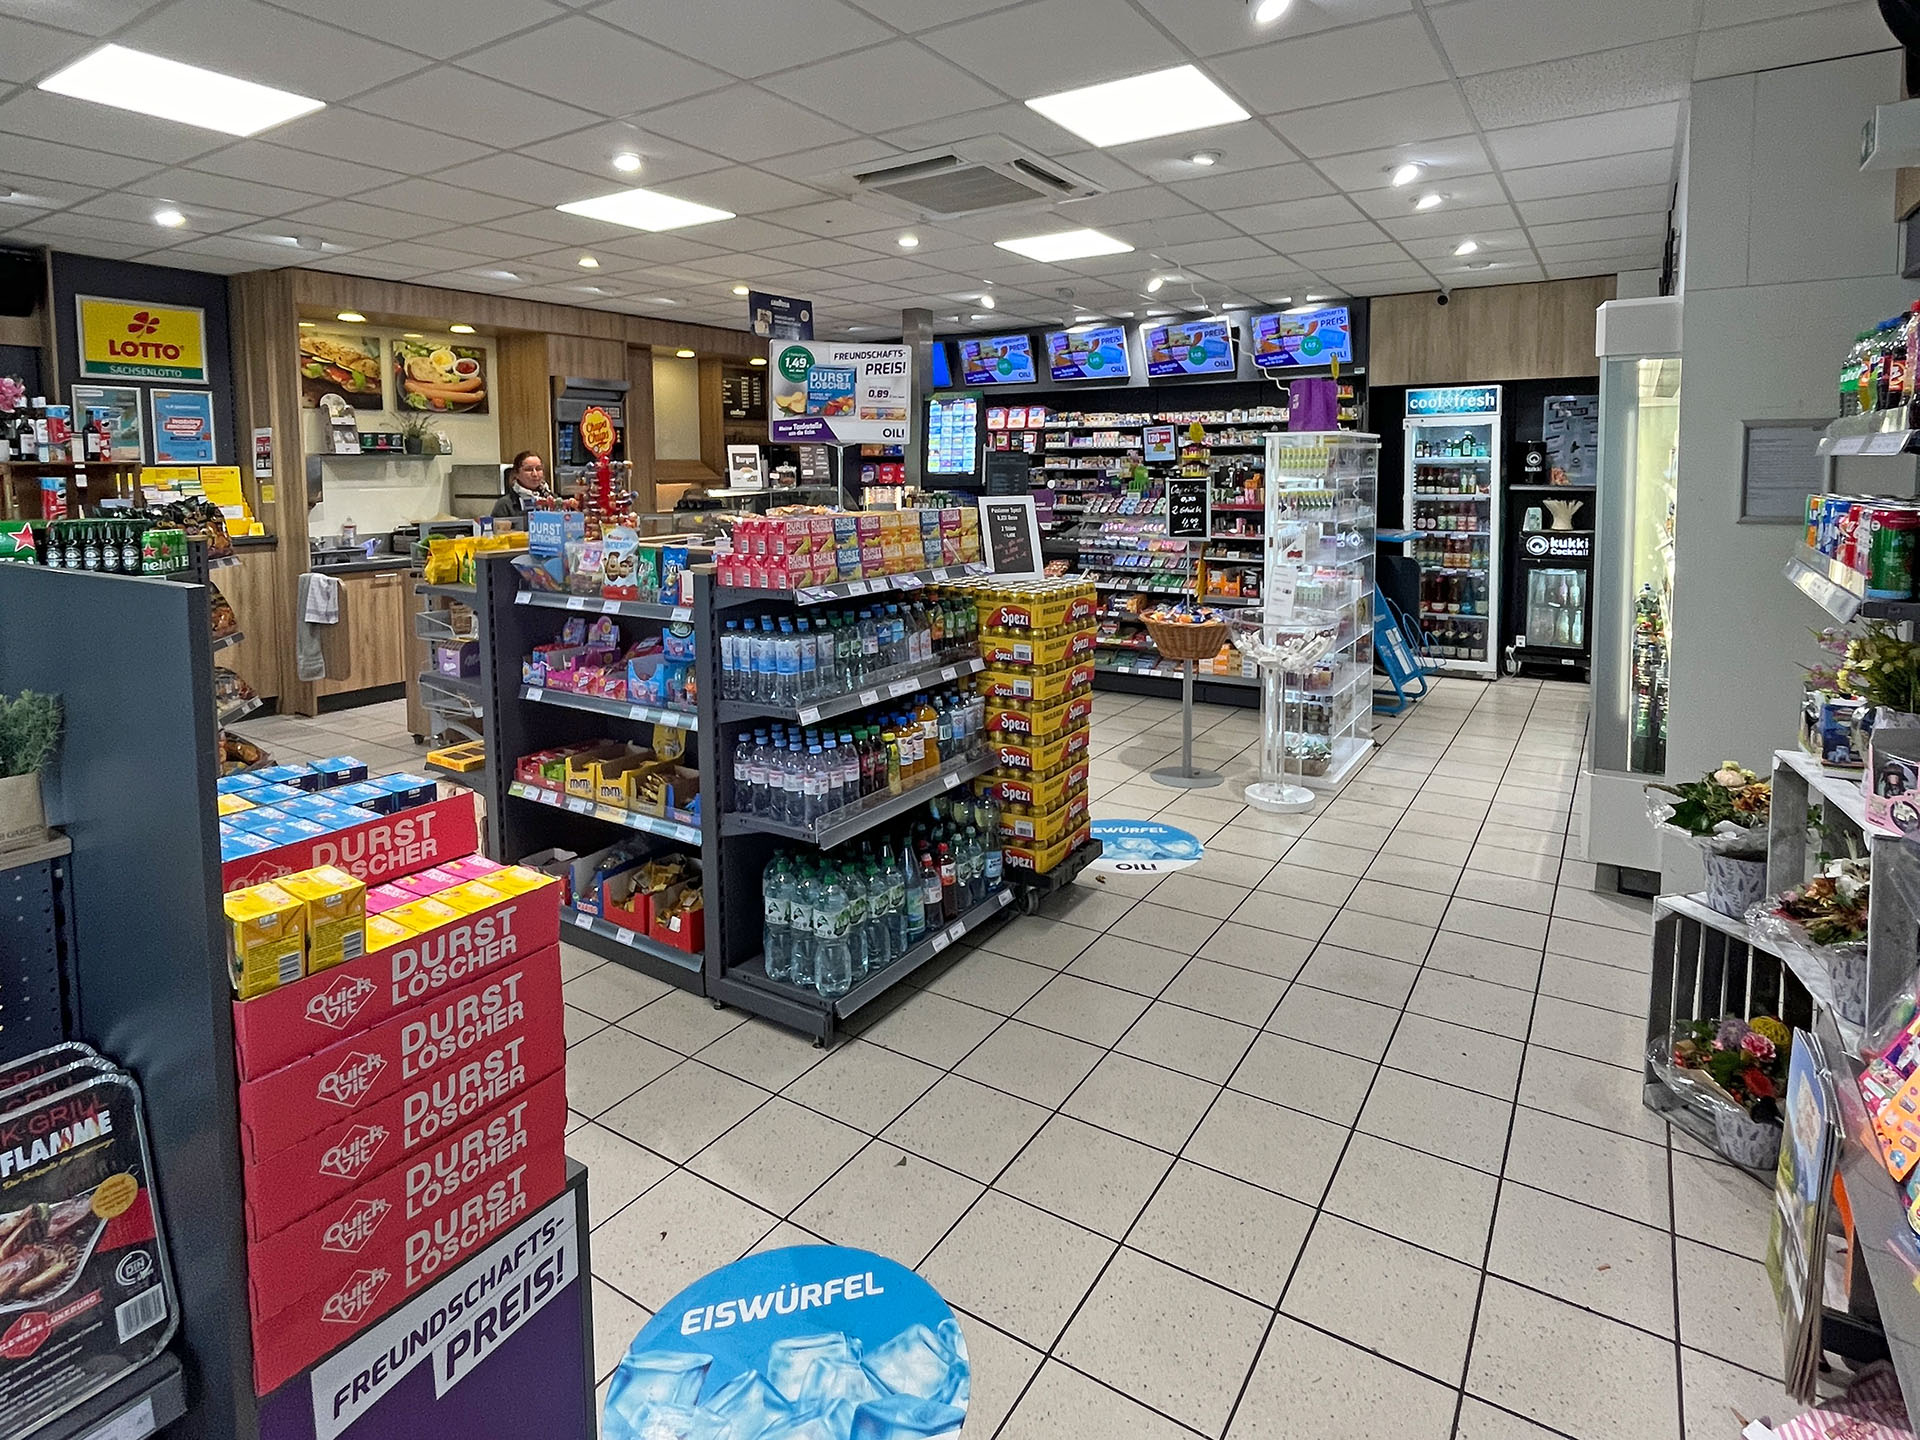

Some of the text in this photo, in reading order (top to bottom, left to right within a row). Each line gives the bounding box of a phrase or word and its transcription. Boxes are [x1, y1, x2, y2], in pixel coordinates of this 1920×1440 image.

[109, 339, 180, 360] LOTTO
[834, 349, 906, 360] FREUNDSCHAFTS-
[109, 365, 182, 377] SACHSENLOTTO
[810, 372, 851, 382] DURST
[865, 362, 906, 375] PREIS!
[868, 389, 889, 398] 0,89
[882, 428, 905, 438] OIL!
[1171, 505, 1179, 515] 2
[529, 522, 562, 534] DURST
[1550, 537, 1589, 549] kukki
[1001, 607, 1029, 626] Spezi
[994, 648, 1013, 660] Spezi
[994, 684, 1013, 696] Spezi
[1001, 713, 1029, 732] Spezi
[1001, 748, 1030, 767] Spezi
[1001, 782, 1031, 801] Spezi
[312, 811, 437, 868] DURST
[1000, 826, 1015, 836] pezi
[1004, 849, 1033, 868] Spezi
[1116, 863, 1157, 871] OIL!
[576, 901, 599, 915] HARIBO
[391, 906, 517, 983] DURST
[391, 934, 517, 1007] LÖSCHER
[307, 978, 371, 1014] Quick
[402, 972, 524, 1056] DURST
[402, 1003, 524, 1079] LÖSCHER
[318, 1053, 381, 1093] Quick
[403, 1036, 525, 1126] DURST
[403, 1065, 525, 1150] LÖSCHER
[0, 1110, 113, 1178] FLAMME
[321, 1125, 383, 1167] Quick
[406, 1101, 528, 1198] DURST
[406, 1129, 528, 1220] LÖSCHER
[323, 1198, 386, 1239] Quick
[405, 1165, 528, 1266] DURST
[405, 1191, 527, 1288] LÖSCHER
[323, 1268, 386, 1314] Quick
[680, 1271, 884, 1336] EISWÜRFEL
[332, 1216, 566, 1420] FREUNDSCHAFTS-
[447, 1246, 565, 1381] PREIS!
